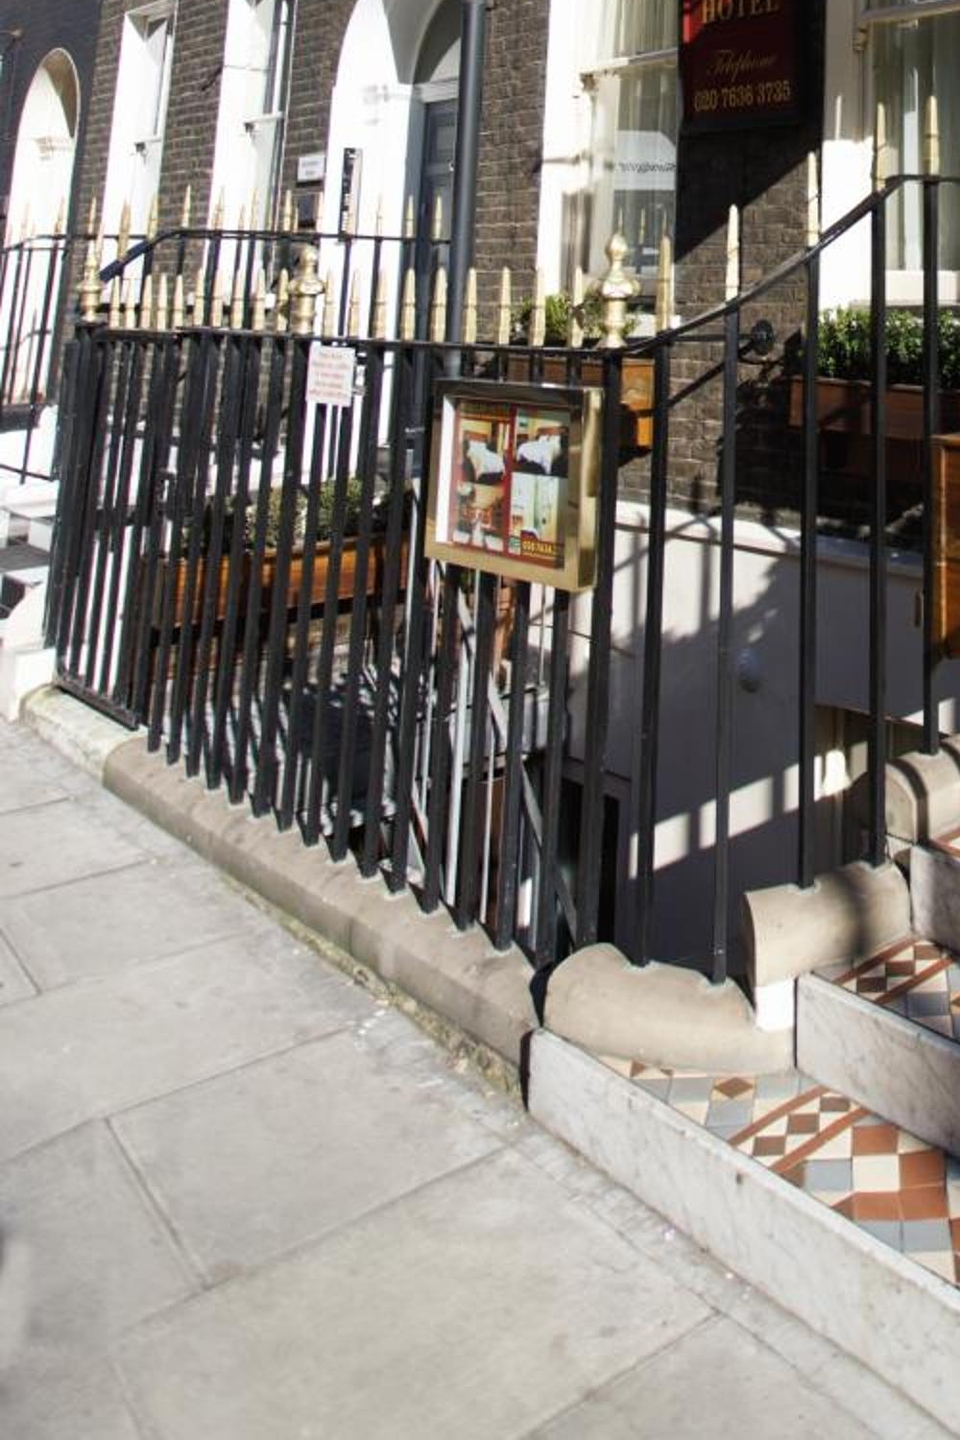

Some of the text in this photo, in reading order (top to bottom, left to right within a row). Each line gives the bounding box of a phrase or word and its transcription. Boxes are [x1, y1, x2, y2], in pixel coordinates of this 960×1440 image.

[693, 80, 791, 112] 020 7636 3735
